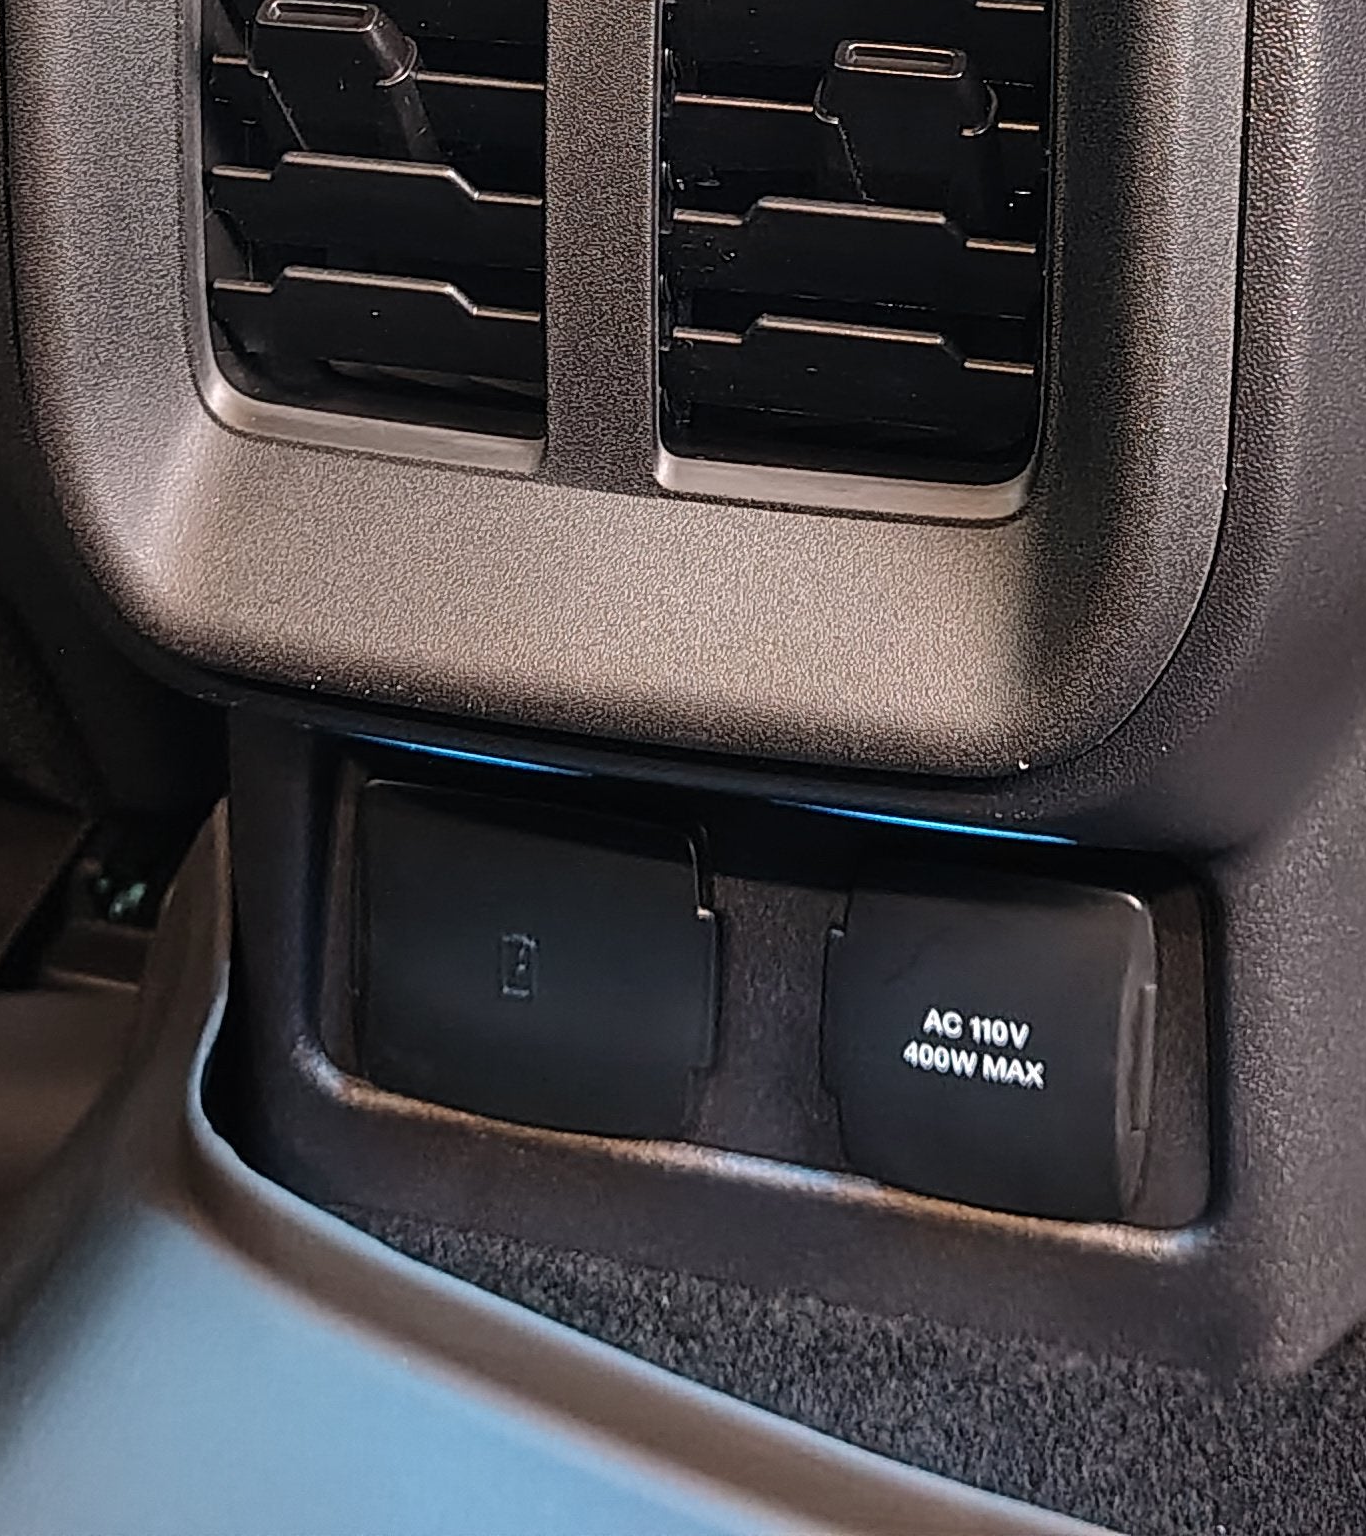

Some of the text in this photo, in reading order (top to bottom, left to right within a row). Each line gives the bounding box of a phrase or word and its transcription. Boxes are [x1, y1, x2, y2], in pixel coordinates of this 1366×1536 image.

[923, 1008, 1030, 1050] AC 110V
[902, 1040, 1045, 1089] 400W MAX
